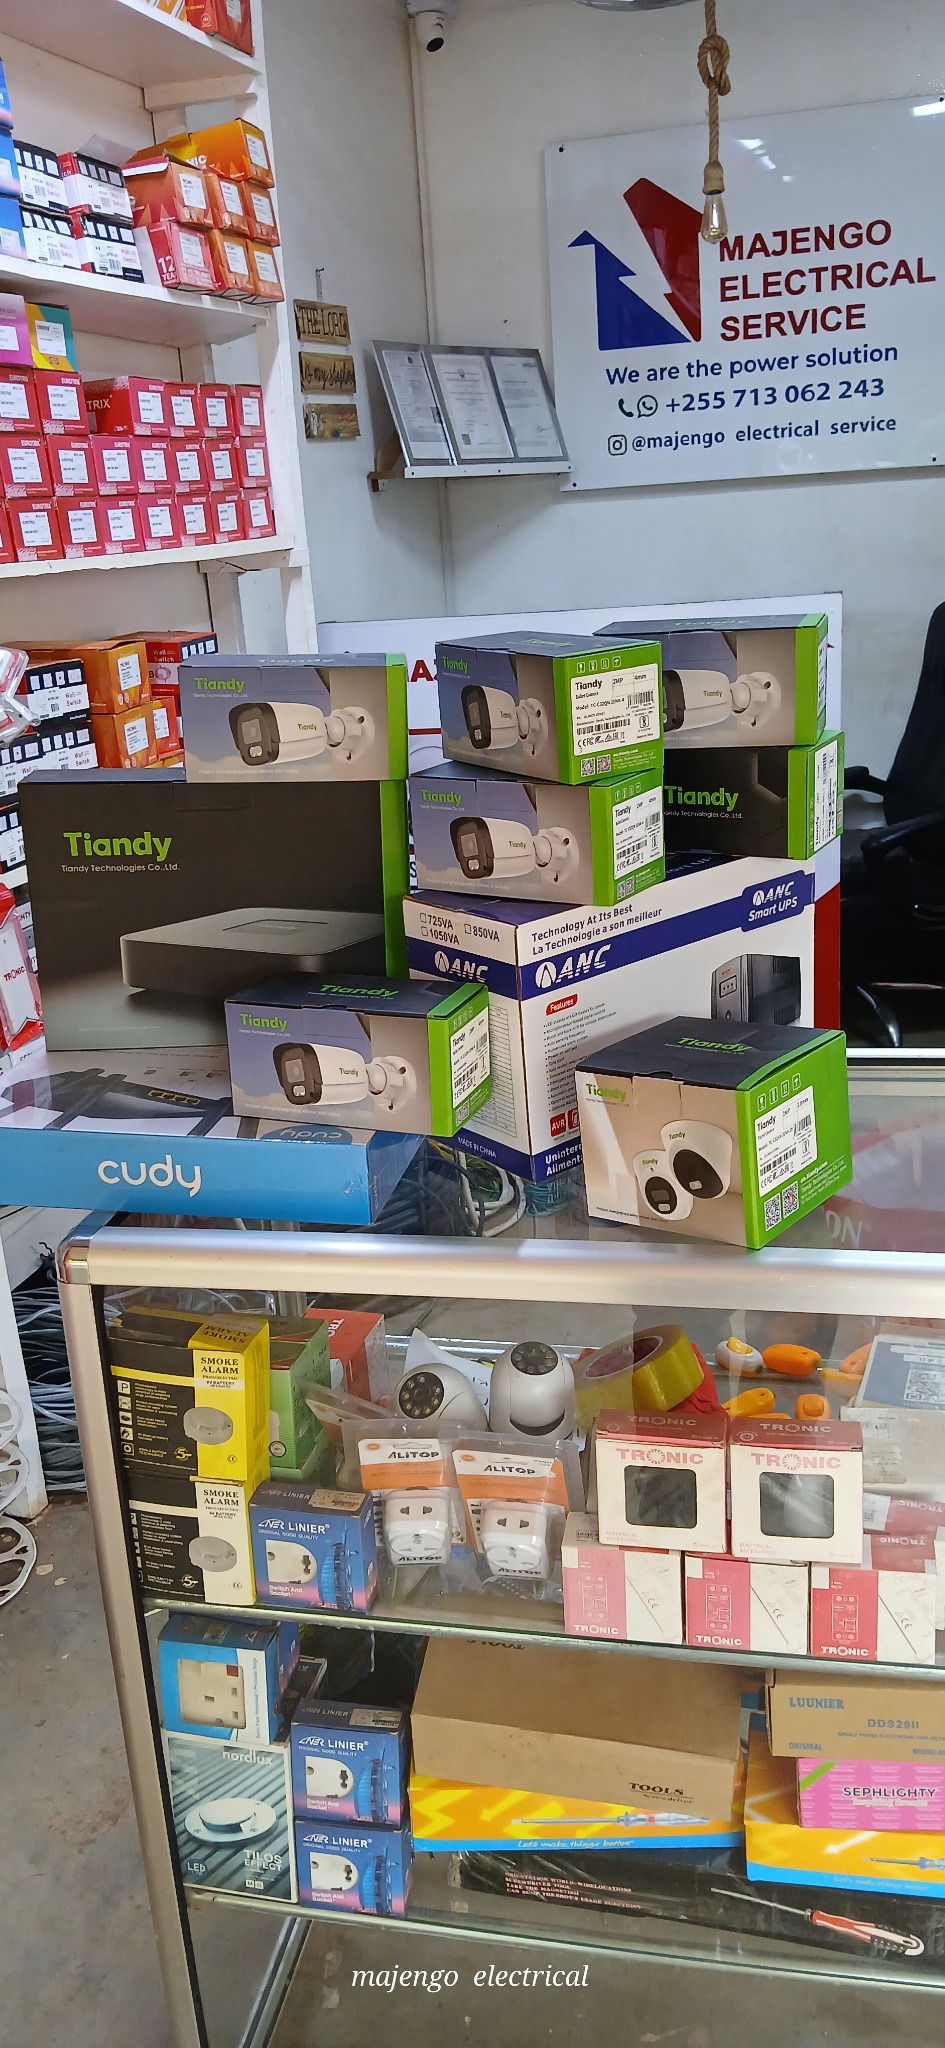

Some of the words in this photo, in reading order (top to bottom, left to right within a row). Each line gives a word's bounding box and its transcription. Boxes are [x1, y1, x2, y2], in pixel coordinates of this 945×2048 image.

[719, 220, 891, 262] MAJENGO
[158, 256, 175, 274] 12
[720, 258, 936, 302] ELECTRICAL
[720, 304, 866, 342] SERVICE
[606, 366, 639, 385] We
[646, 366, 680, 382] are
[686, 360, 723, 379] the
[730, 353, 798, 379] power
[806, 344, 898, 368] solution
[666, 393, 726, 413] +255
[734, 387, 777, 408] 713
[785, 382, 830, 404] 062
[838, 378, 884, 398] 243
[632, 427, 725, 451] @majengo
[736, 420, 819, 442] electrical
[830, 416, 897, 435] service
[443, 656, 468, 674] Tiandy
[195, 678, 245, 693] Tiandy
[576, 679, 602, 690] Tiandy
[421, 790, 461, 806] Tiandy
[664, 786, 739, 812] Tiandy
[615, 806, 631, 818] Tiandy
[63, 832, 172, 862] Tiandy
[509, 841, 526, 849] Tiandy
[62, 865, 89, 873] Tiandy
[91, 864, 146, 872] Technologies
[764, 881, 795, 903] ANC
[749, 905, 777, 922] Smart
[778, 897, 798, 912] UPS
[428, 914, 454, 931] 725VA
[473, 926, 500, 942] 850VA
[532, 920, 585, 942] Technology
[587, 914, 596, 925] At
[598, 907, 611, 921] Its
[614, 904, 633, 917] Best
[429, 928, 460, 945] 1050VA
[533, 946, 543, 955] La
[545, 925, 600, 952] Technologie
[610, 920, 625, 931] son
[626, 908, 662, 927] meilleur
[556, 943, 611, 983] ANC
[4, 966, 25, 982] TRONIC
[449, 958, 489, 983] ANC
[320, 985, 399, 997] Tiandy
[550, 999, 574, 1012] Features
[240, 1014, 288, 1032] Tiandy
[678, 1038, 753, 1052] Tiandy
[339, 1068, 358, 1077] Tiandy
[586, 1084, 626, 1103] Tiandy
[552, 1120, 565, 1131] AVR
[758, 1115, 777, 1133] Tiandy
[280, 1128, 342, 1139] cudy
[458, 1137, 474, 1149] MADE
[480, 1145, 497, 1158] CHINA
[98, 1154, 201, 1198] cudy
[201, 1357, 239, 1366] SMOKE
[201, 1366, 239, 1374] ALARM
[628, 1416, 696, 1426] TRONIC
[760, 1424, 832, 1433] TRONIC
[616, 1448, 704, 1465] TRONIC
[751, 1453, 841, 1471] TRONIC
[203, 1490, 239, 1498] SMOKE
[284, 1492, 311, 1500] LINIER
[204, 1498, 240, 1507] ALARM
[899, 1500, 944, 1513] TRONIC
[288, 1522, 326, 1534] LINIER
[880, 1537, 926, 1546] TRONIC
[574, 1624, 619, 1635] TRONIC
[696, 1635, 743, 1646] TRONIC
[821, 1645, 869, 1656] TRONIC
[789, 1697, 845, 1710] LUUNIER
[322, 1709, 348, 1717] LINIER
[328, 1740, 365, 1752] LINIER
[789, 1743, 823, 1751] ORIGINAL
[223, 1750, 273, 1766] nordlux
[629, 1782, 684, 1796] TOOLS
[844, 1787, 936, 1798] SEPHLIGHTY
[332, 1837, 368, 1848] LINIER
[244, 1850, 282, 1864] TILOS
[188, 1862, 206, 1872] LED
[245, 1860, 282, 1872] EFFECT
